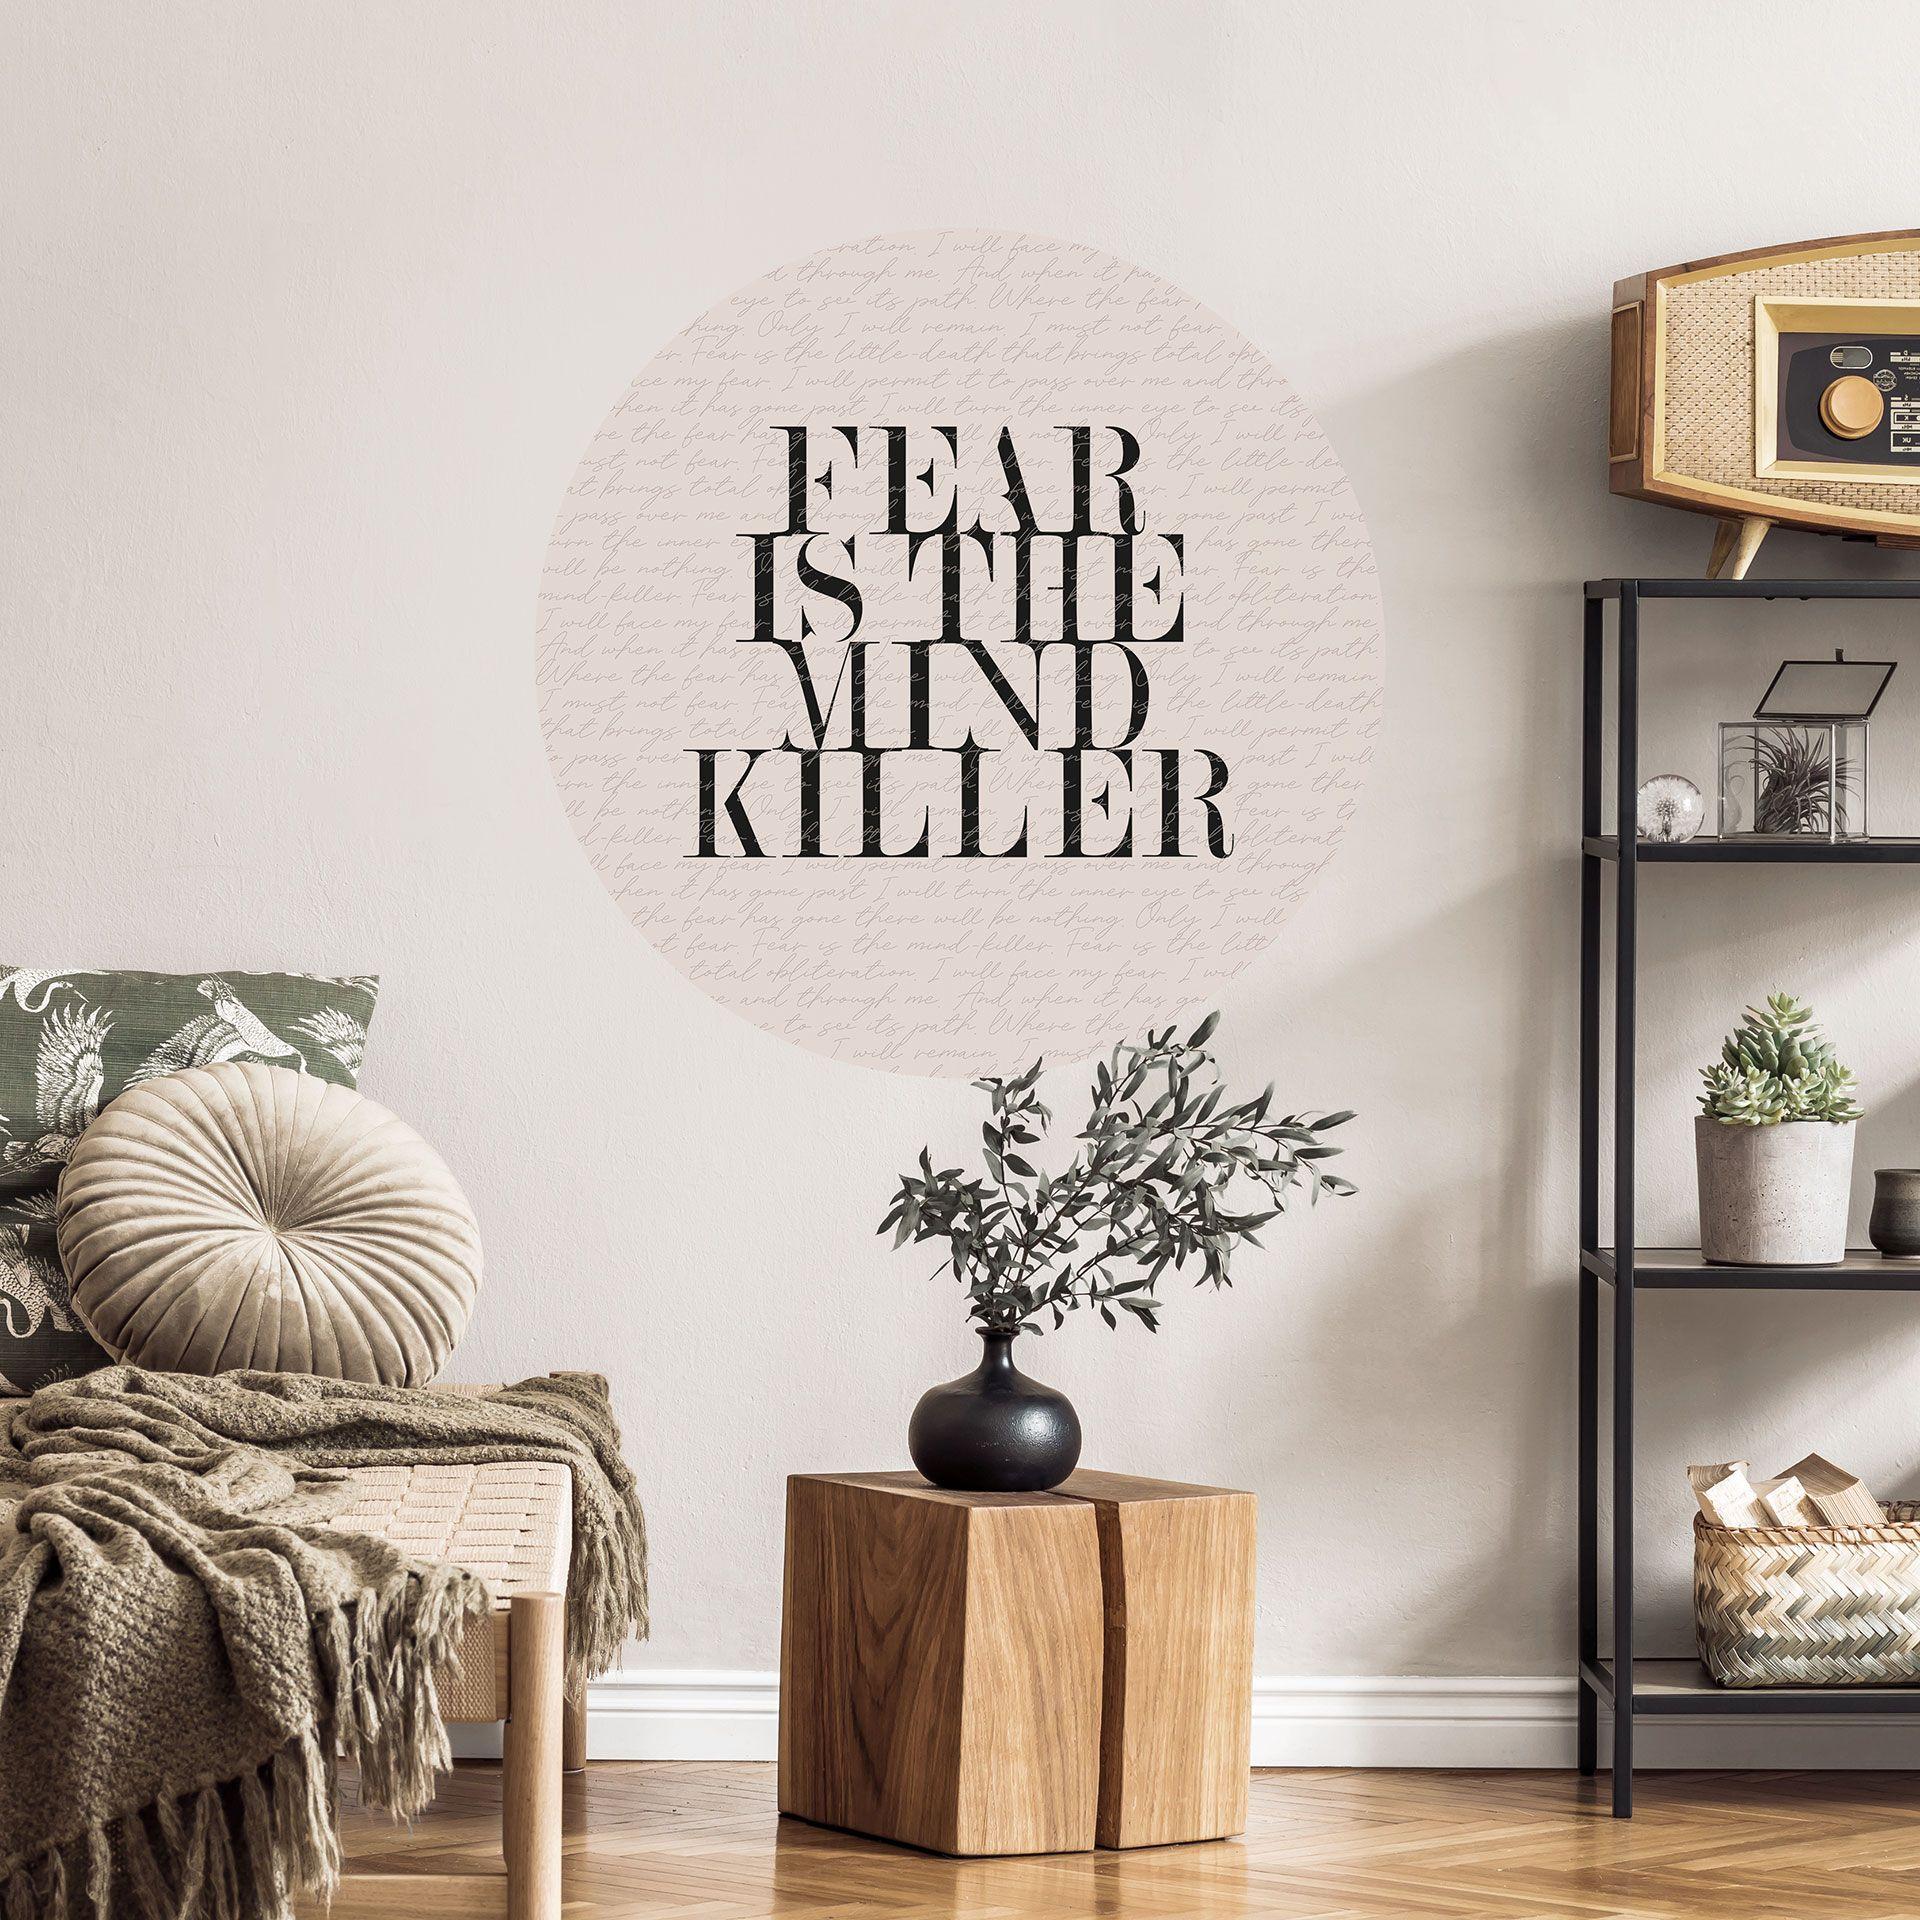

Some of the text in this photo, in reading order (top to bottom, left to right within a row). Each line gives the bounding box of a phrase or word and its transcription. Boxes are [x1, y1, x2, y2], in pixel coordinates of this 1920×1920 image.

[953, 234, 1060, 260] will face
[797, 256, 1120, 294] through And when it
[784, 288, 813, 307] to
[866, 288, 905, 310] its
[987, 284, 1077, 310] Where
[1084, 284, 1131, 310] the
[1136, 288, 1192, 314] fear
[758, 311, 825, 345] Only
[862, 315, 912, 333] will
[1046, 315, 1111, 337] must
[1119, 315, 1163, 334] not
[692, 336, 750, 364] Fear
[752, 346, 780, 363] is
[784, 337, 831, 363] the
[1000, 337, 1062, 361] that
[1063, 336, 1148, 374] brings
[1151, 339, 1224, 361] total
[672, 374, 711, 398] my
[805, 368, 858, 386] will
[856, 368, 955, 399] permit
[956, 367, 986, 387] it
[988, 368, 1017, 387] to
[1012, 375, 1080, 399] pass
[1083, 375, 1138, 385] over
[1183, 365, 1233, 388] and
[671, 391, 1220, 428] it has gone past will turn the inner eye to
[630, 418, 1288, 448] the fear will
[635, 449, 683, 468] not
[1164, 445, 1213, 471] the
[601, 471, 1348, 509] brings total will permit
[770, 426, 1146, 535] FEAR
[636, 503, 1299, 536] over gone past
[600, 526, 1303, 563] the inner has gone
[590, 552, 628, 577] be
[1231, 551, 1290, 579] Fear
[1300, 561, 1326, 578] is
[692, 578, 750, 606] Fear
[736, 534, 1184, 642] IS THE
[559, 605, 1337, 643] will face my and through
[540, 632, 594, 658] And
[602, 633, 664, 659] when
[671, 636, 699, 656] it
[1192, 637, 1220, 656] to
[1270, 637, 1308, 659] its
[630, 660, 1288, 690] the fear has will
[563, 691, 629, 713] must
[635, 691, 683, 710] not
[1164, 687, 1213, 713] the
[772, 641, 1149, 750] MIND
[601, 713, 1348, 751] brings total will permit
[559, 745, 1299, 776] pass past
[600, 767, 1303, 804] the gone
[590, 793, 1326, 821] be Fear is
[683, 749, 1235, 858] KILLER
[613, 852, 665, 878] face
[671, 875, 1308, 912] it has gone past will turn the inner eye to its
[680, 906, 738, 932] fear
[733, 902, 784, 928] has
[789, 913, 847, 939] gone
[854, 902, 926, 928] there
[934, 906, 988, 924] will
[983, 902, 1022, 927] be
[1135, 902, 1203, 936] Only
[1235, 906, 1288, 924] will
[751, 928, 810, 956] Fear
[818, 938, 845, 955] is
[850, 929, 898, 955] the
[1065, 928, 1123, 956] Fear
[1132, 938, 1160, 955] is
[1164, 929, 1213, 955] the
[689, 958, 762, 980] total
[953, 960, 1004, 978] will
[1008, 960, 1060, 986] face
[1069, 966, 1107, 990] my
[740, 981, 1168, 1019] and through And when it has
[784, 1009, 1131, 1035] to its Where the
[851, 1040, 905, 1058] will
